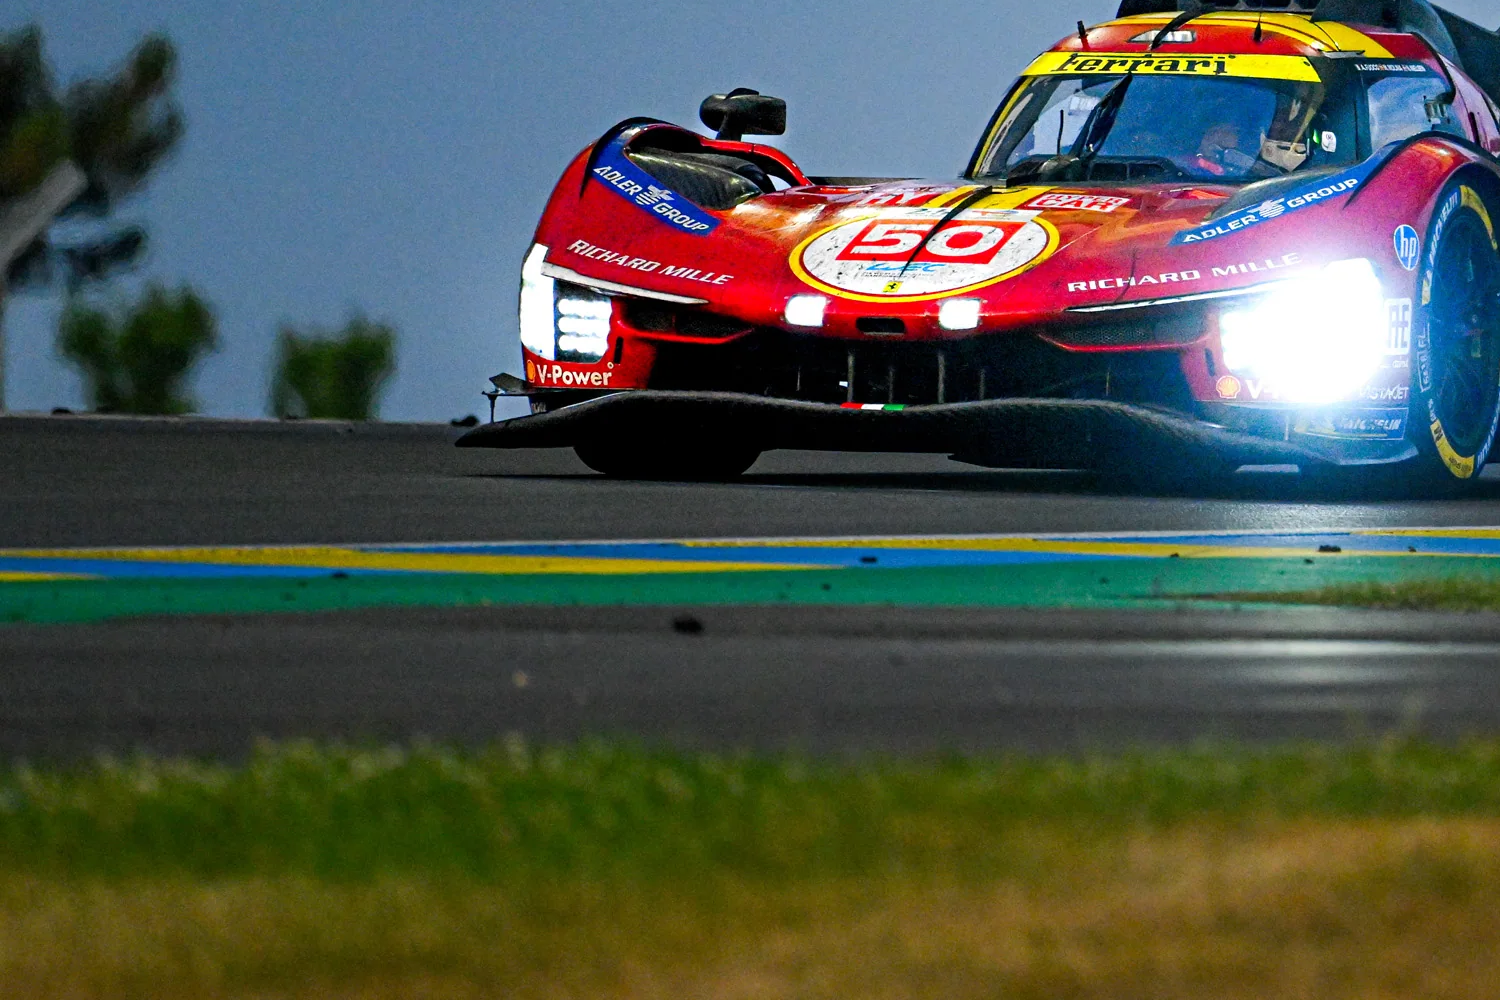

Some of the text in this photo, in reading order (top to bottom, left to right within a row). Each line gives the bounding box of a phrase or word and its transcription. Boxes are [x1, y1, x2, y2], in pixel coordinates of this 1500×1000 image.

[1050, 53, 1237, 75] Ferrari
[593, 165, 709, 232] ADLER GROUP
[1036, 198, 1115, 211] CAR
[1182, 178, 1359, 243] ADLER GROUP
[850, 223, 1005, 257] 50
[1394, 225, 1418, 270] hp
[566, 239, 734, 285] RICHARD MILLE
[1067, 252, 1302, 293] RICHARD MILLE
[536, 364, 612, 386] V-Power
